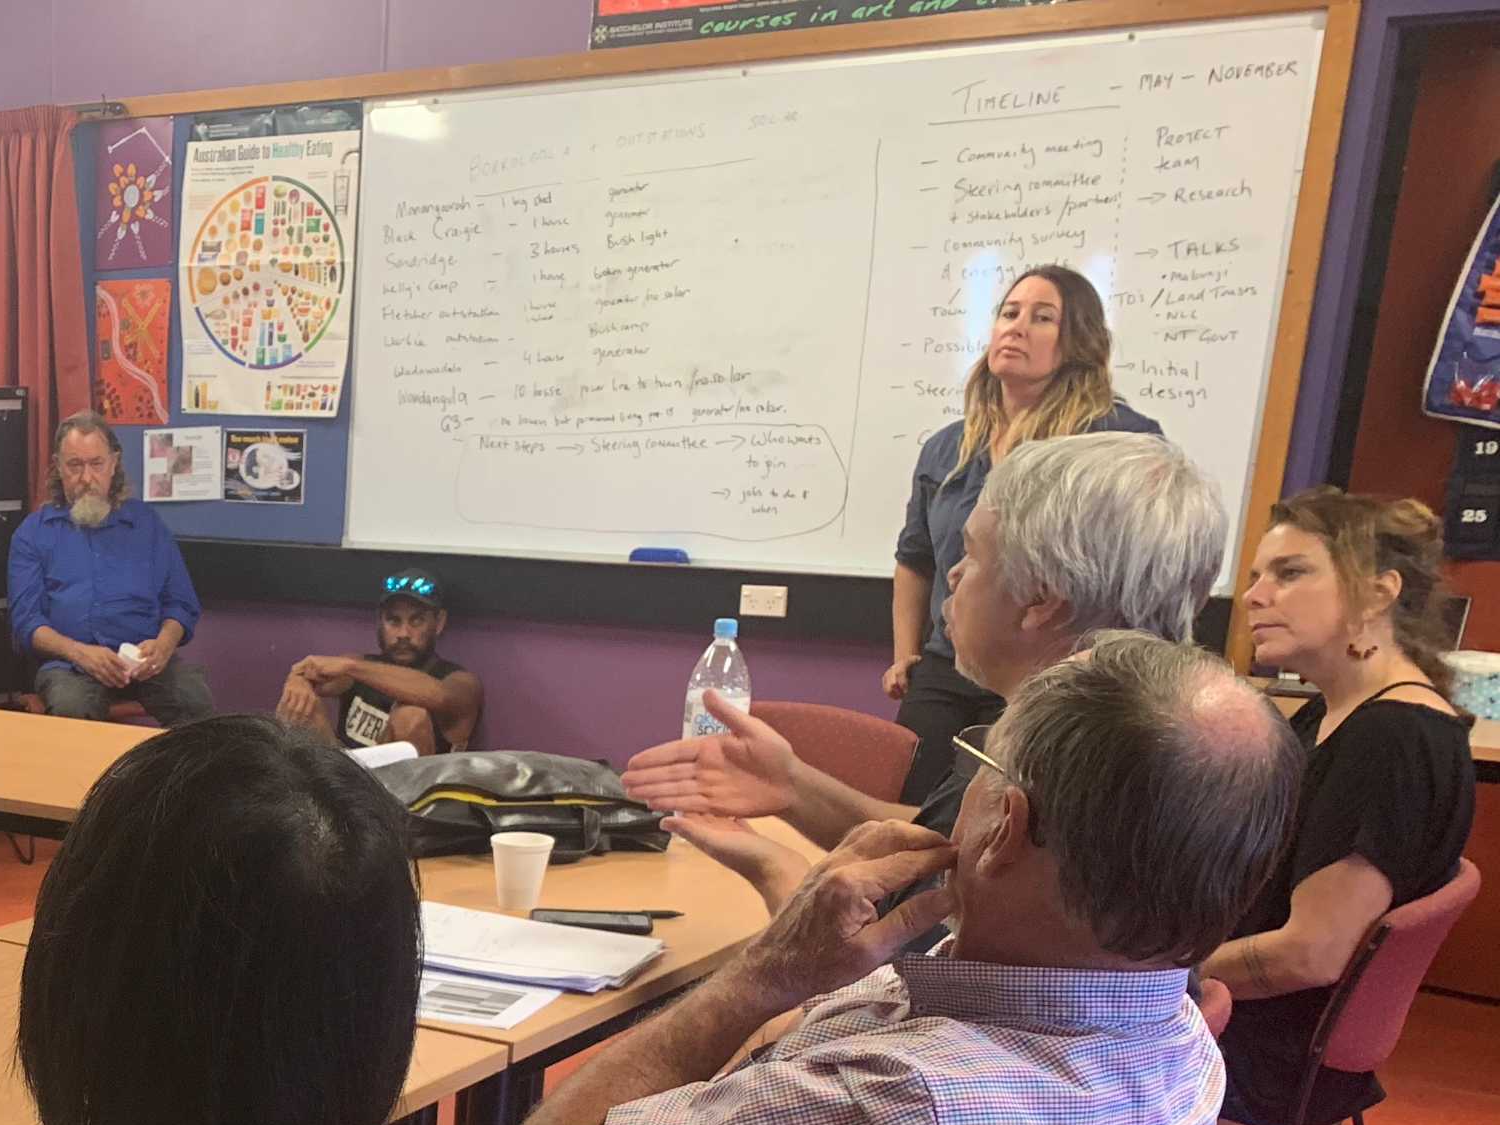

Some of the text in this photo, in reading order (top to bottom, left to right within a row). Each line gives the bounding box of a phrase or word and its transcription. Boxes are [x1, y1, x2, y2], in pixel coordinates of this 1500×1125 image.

[700, 11, 796, 35] courses
[810, 6, 837, 23] in
[851, 2, 894, 20] art
[952, 61, 1298, 115] TIMELINE MAY NOVEMBER
[193, 138, 333, 163] Australian Guide to Healthy Eating
[1045, 138, 1103, 158] meeting
[1154, 156, 1200, 174] team
[1174, 178, 1252, 204] Research
[1168, 238, 1240, 259] TALKS
[1142, 359, 1199, 381] Initial
[1140, 382, 1207, 409] design
[1475, 440, 1499, 456] 19
[1460, 508, 1489, 524] 25
